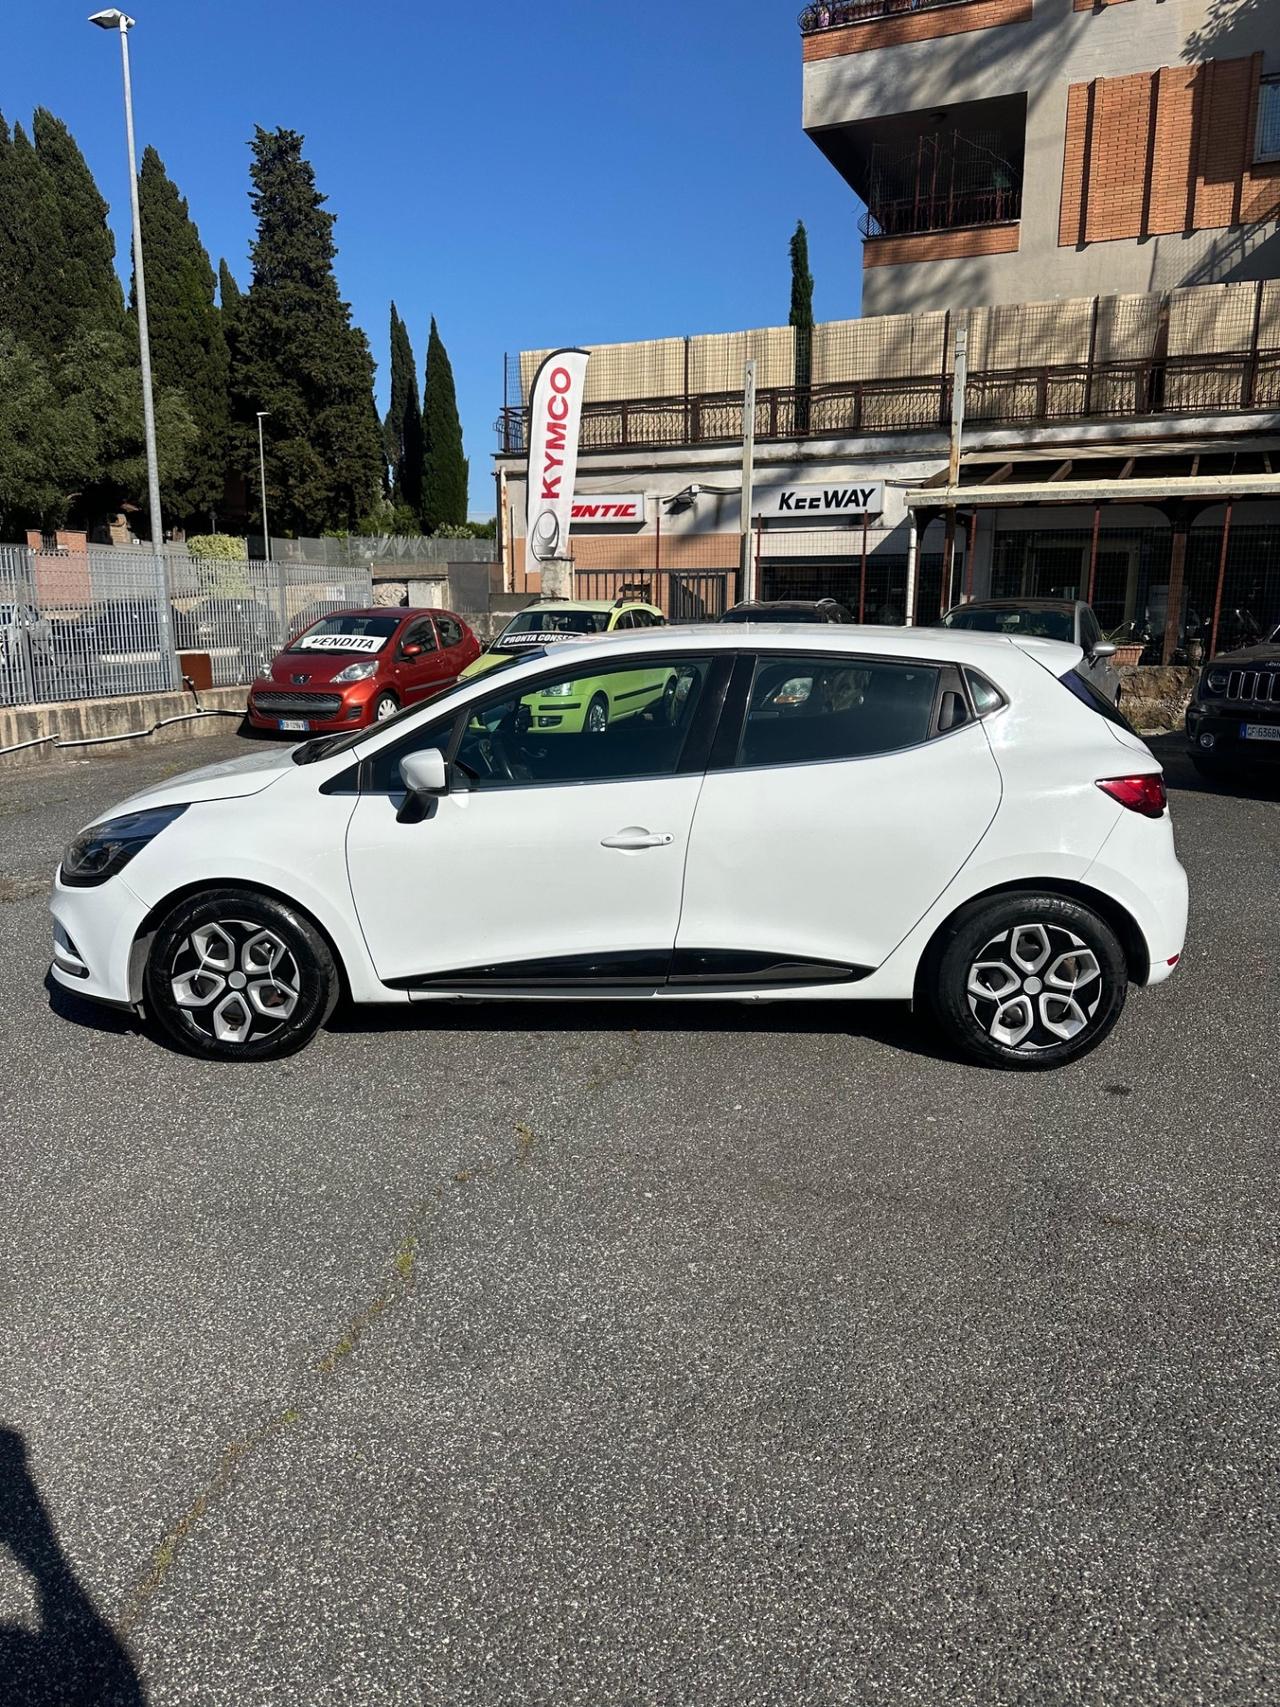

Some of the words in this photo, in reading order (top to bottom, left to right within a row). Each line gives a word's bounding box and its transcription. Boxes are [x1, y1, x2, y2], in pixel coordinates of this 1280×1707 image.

[541, 367, 571, 499] KYMCO
[571, 504, 636, 517] ANTIC
[312, 637, 374, 649] VENDITA
[503, 635, 536, 644] PRONTA
